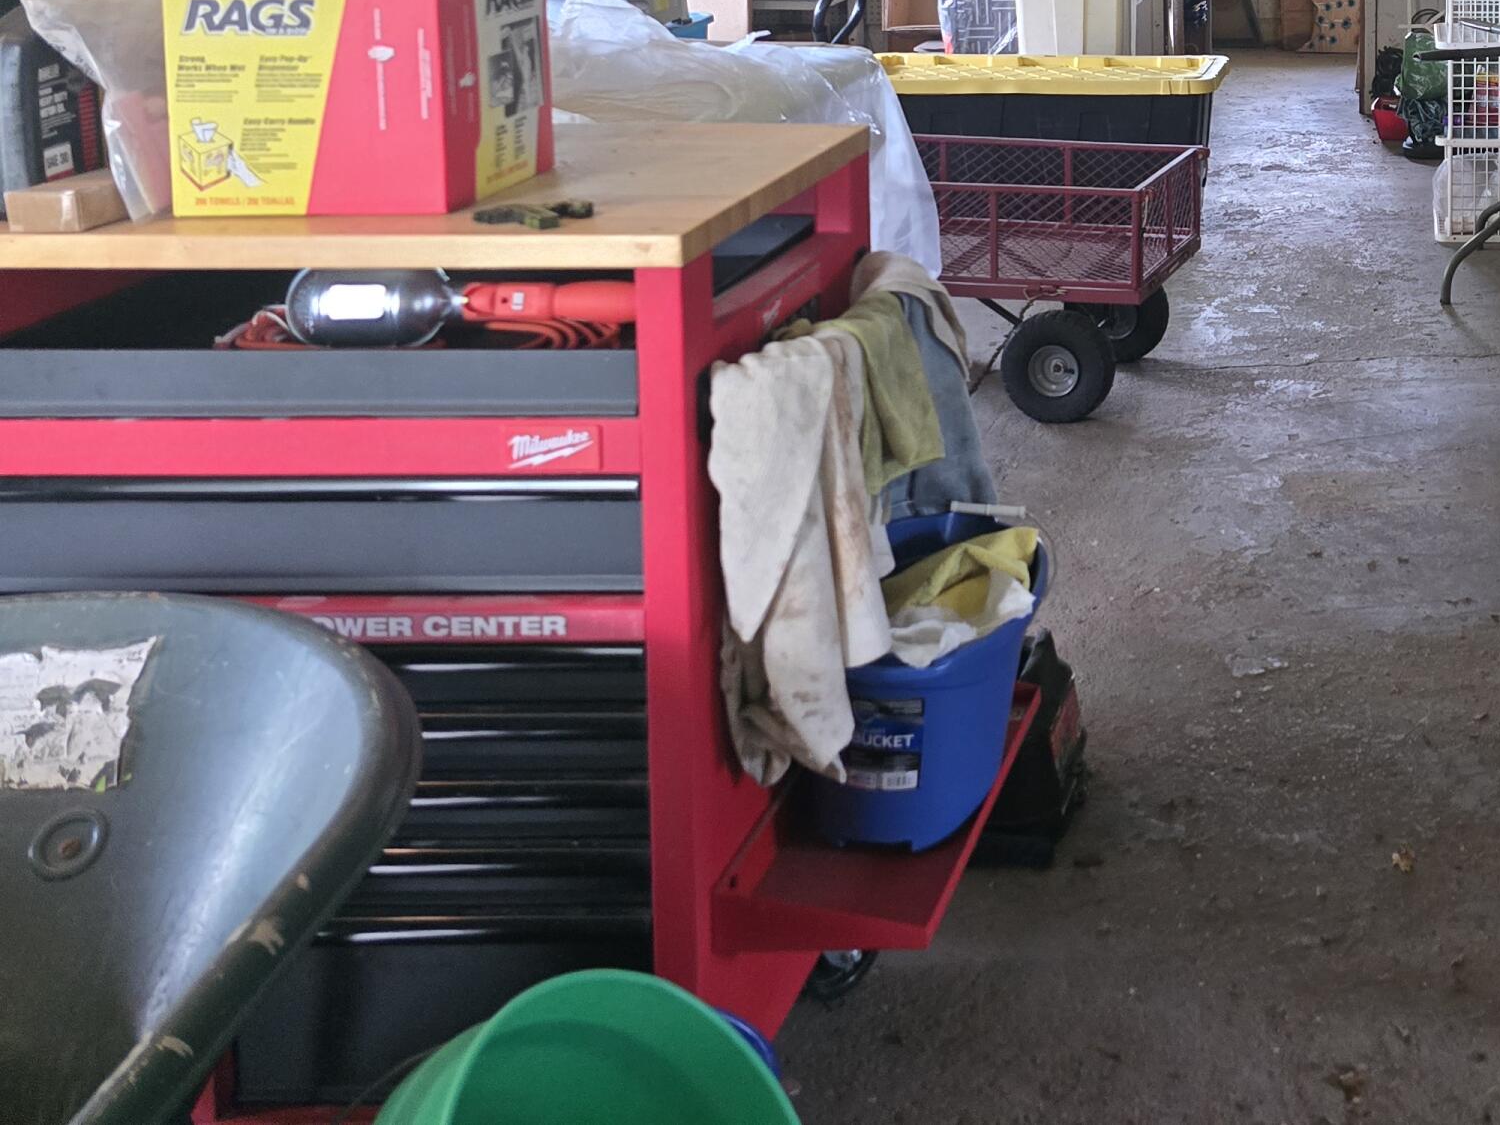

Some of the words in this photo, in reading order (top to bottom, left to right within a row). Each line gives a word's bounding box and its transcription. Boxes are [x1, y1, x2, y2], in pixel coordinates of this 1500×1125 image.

[508, 429, 590, 461] Milwaukee
[311, 615, 413, 637] OWER
[422, 615, 567, 637] CENTER
